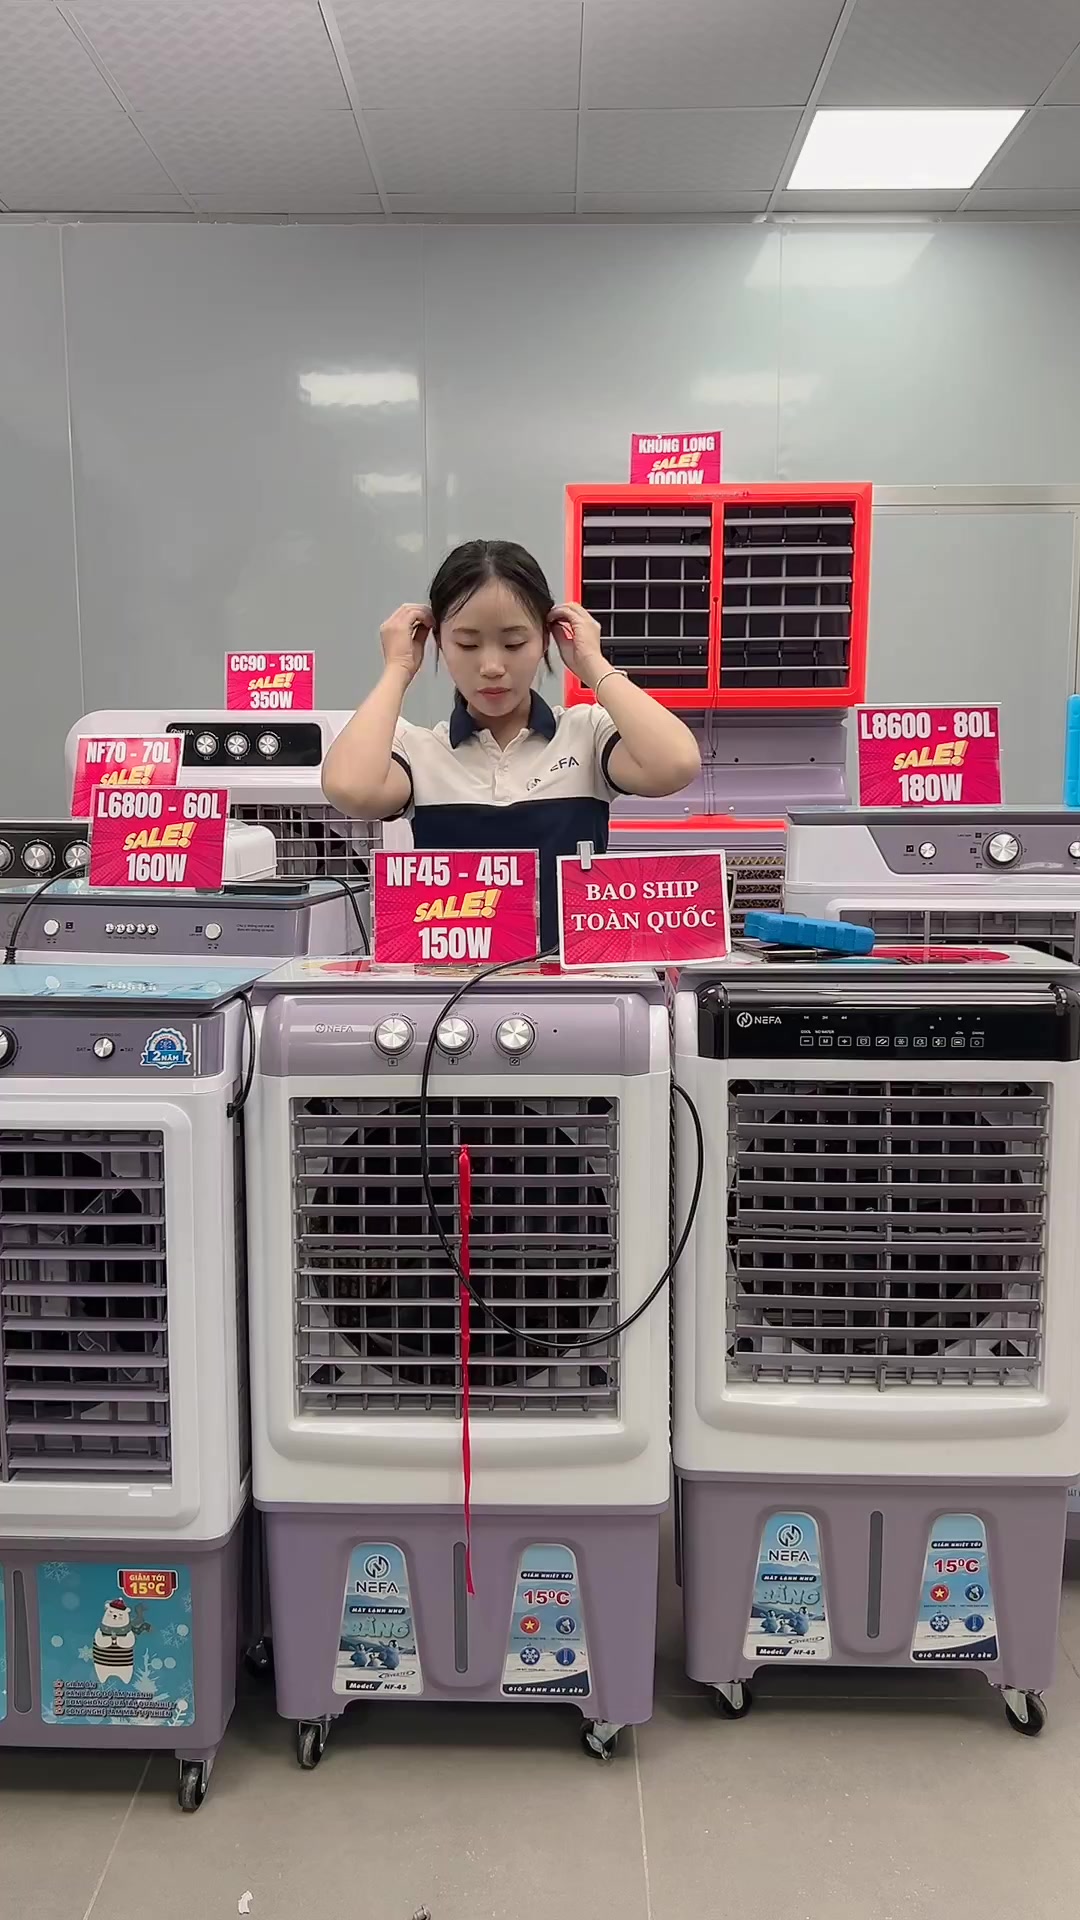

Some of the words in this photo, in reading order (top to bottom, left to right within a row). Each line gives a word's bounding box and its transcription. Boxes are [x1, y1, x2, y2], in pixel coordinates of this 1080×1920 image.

[638, 434, 680, 454] KHỦNG
[683, 436, 715, 452] LONG
[651, 452, 702, 472] SALE!
[646, 470, 704, 484] 1000W
[231, 655, 266, 672] CC90
[279, 654, 311, 671] 130L
[247, 672, 295, 691] SALE!
[250, 690, 293, 709] 350W
[861, 712, 931, 739] L8600
[953, 711, 996, 738] 80L
[86, 741, 126, 763] NF70
[142, 741, 172, 763] 70L
[892, 740, 969, 771] SALE!
[100, 764, 155, 785] SALE!
[898, 773, 963, 802] 180W
[97, 791, 163, 818] L6800
[183, 792, 222, 819] 60L
[122, 822, 197, 851] SALE!
[126, 853, 188, 882] 160W
[386, 856, 451, 887] NF45
[475, 856, 524, 887] 45L
[585, 882, 636, 900] BAO
[643, 880, 699, 899] SHIP
[413, 888, 502, 923] SALE!
[571, 908, 640, 931] TOÀN
[647, 905, 716, 933] QUỐC
[418, 926, 493, 960] 150W
[326, 1025, 354, 1033] NEFA
[754, 1015, 782, 1025] NEFA
[152, 1050, 161, 1061] 2
[768, 1550, 810, 1562] NEFA
[129, 1573, 150, 1581] GIẢM
[151, 1573, 165, 1582] TỚI
[356, 1581, 399, 1593] NEFA
[759, 1584, 820, 1605] BĂNG
[348, 1617, 409, 1638] BĂNG
